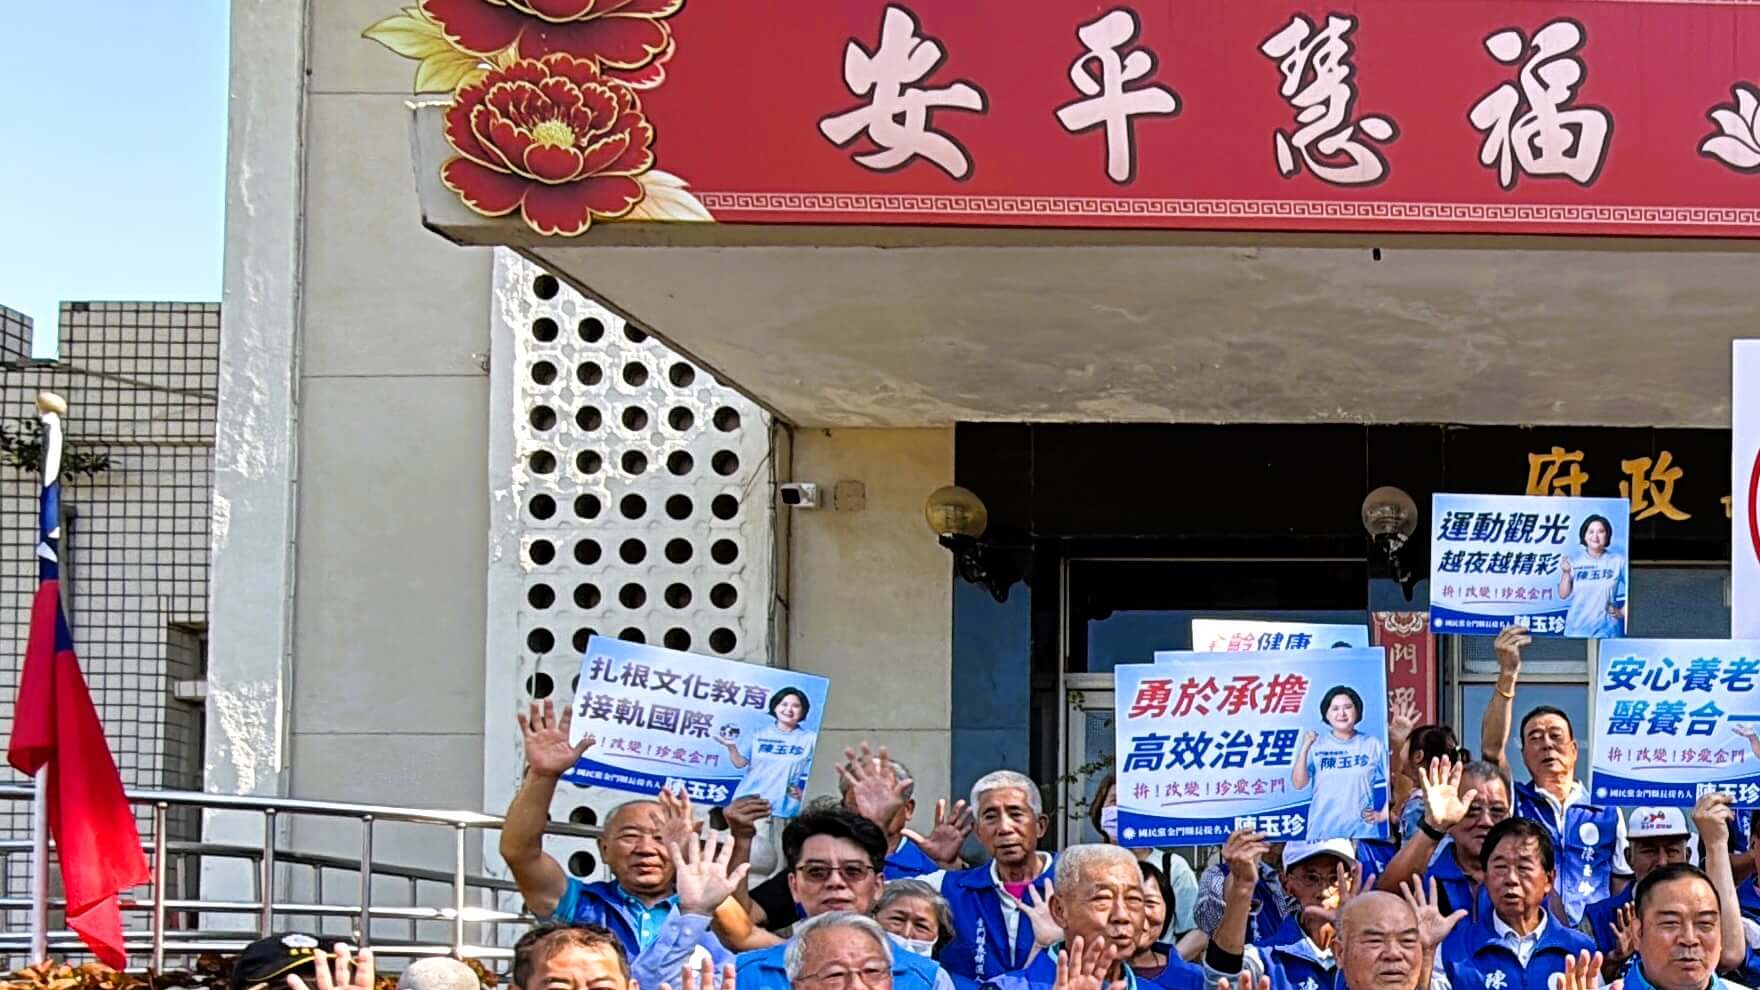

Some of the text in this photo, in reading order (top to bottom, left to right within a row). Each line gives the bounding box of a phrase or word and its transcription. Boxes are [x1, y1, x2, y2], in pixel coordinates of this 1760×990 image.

[1437, 511, 1570, 545] 運動觀光
[1437, 550, 1561, 576] 越夜越精彩
[1208, 632, 1312, 651] 齡健康
[590, 657, 770, 710] 扎根文化教育
[1128, 674, 1308, 718] 勇於承擔
[578, 691, 714, 738] 接軌國際
[1123, 729, 1299, 772] 高效治理
